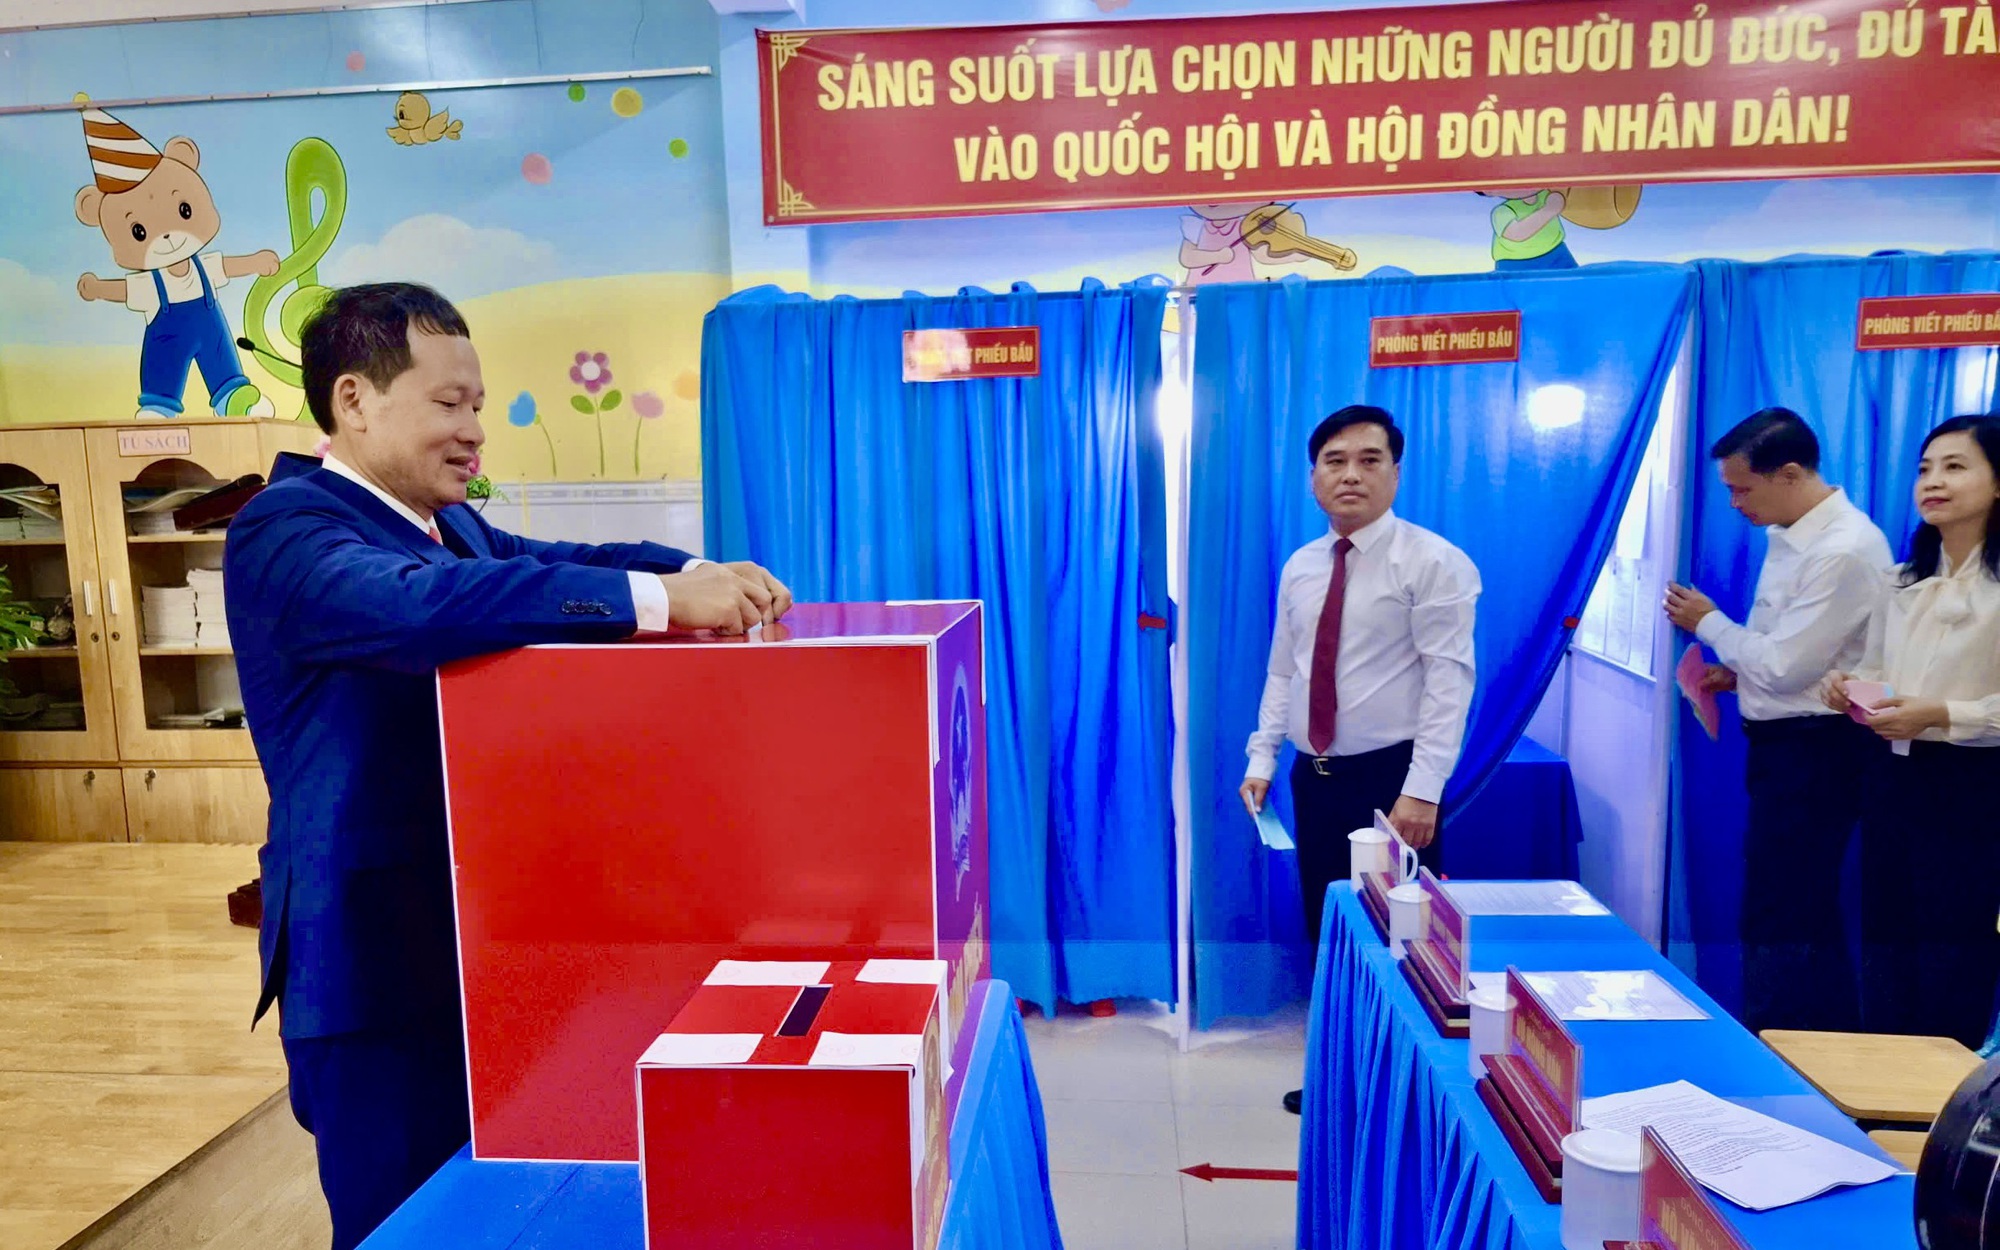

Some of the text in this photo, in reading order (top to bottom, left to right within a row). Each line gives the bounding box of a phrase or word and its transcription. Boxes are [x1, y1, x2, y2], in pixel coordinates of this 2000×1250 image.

[817, 0, 2000, 111] SÁNG SUỐT LỰA CHỌN NHỮNG NGƯỜI ĐỦ ĐỨC, ĐỦ TÀ
[953, 86, 1851, 184] VÀO QUỐC HỘI VÀ HỘI ĐỒNG NHÂN DÂN!
[1864, 313, 1911, 335] PHÒNG
[1913, 310, 1942, 334] VIẾT
[1943, 308, 1982, 333] PHIẾU
[974, 341, 1009, 364] PHIẾU
[1376, 325, 1513, 354] PHÒNG VIẾT PHIẾU BẦU
[144, 432, 188, 449] SÁCH
